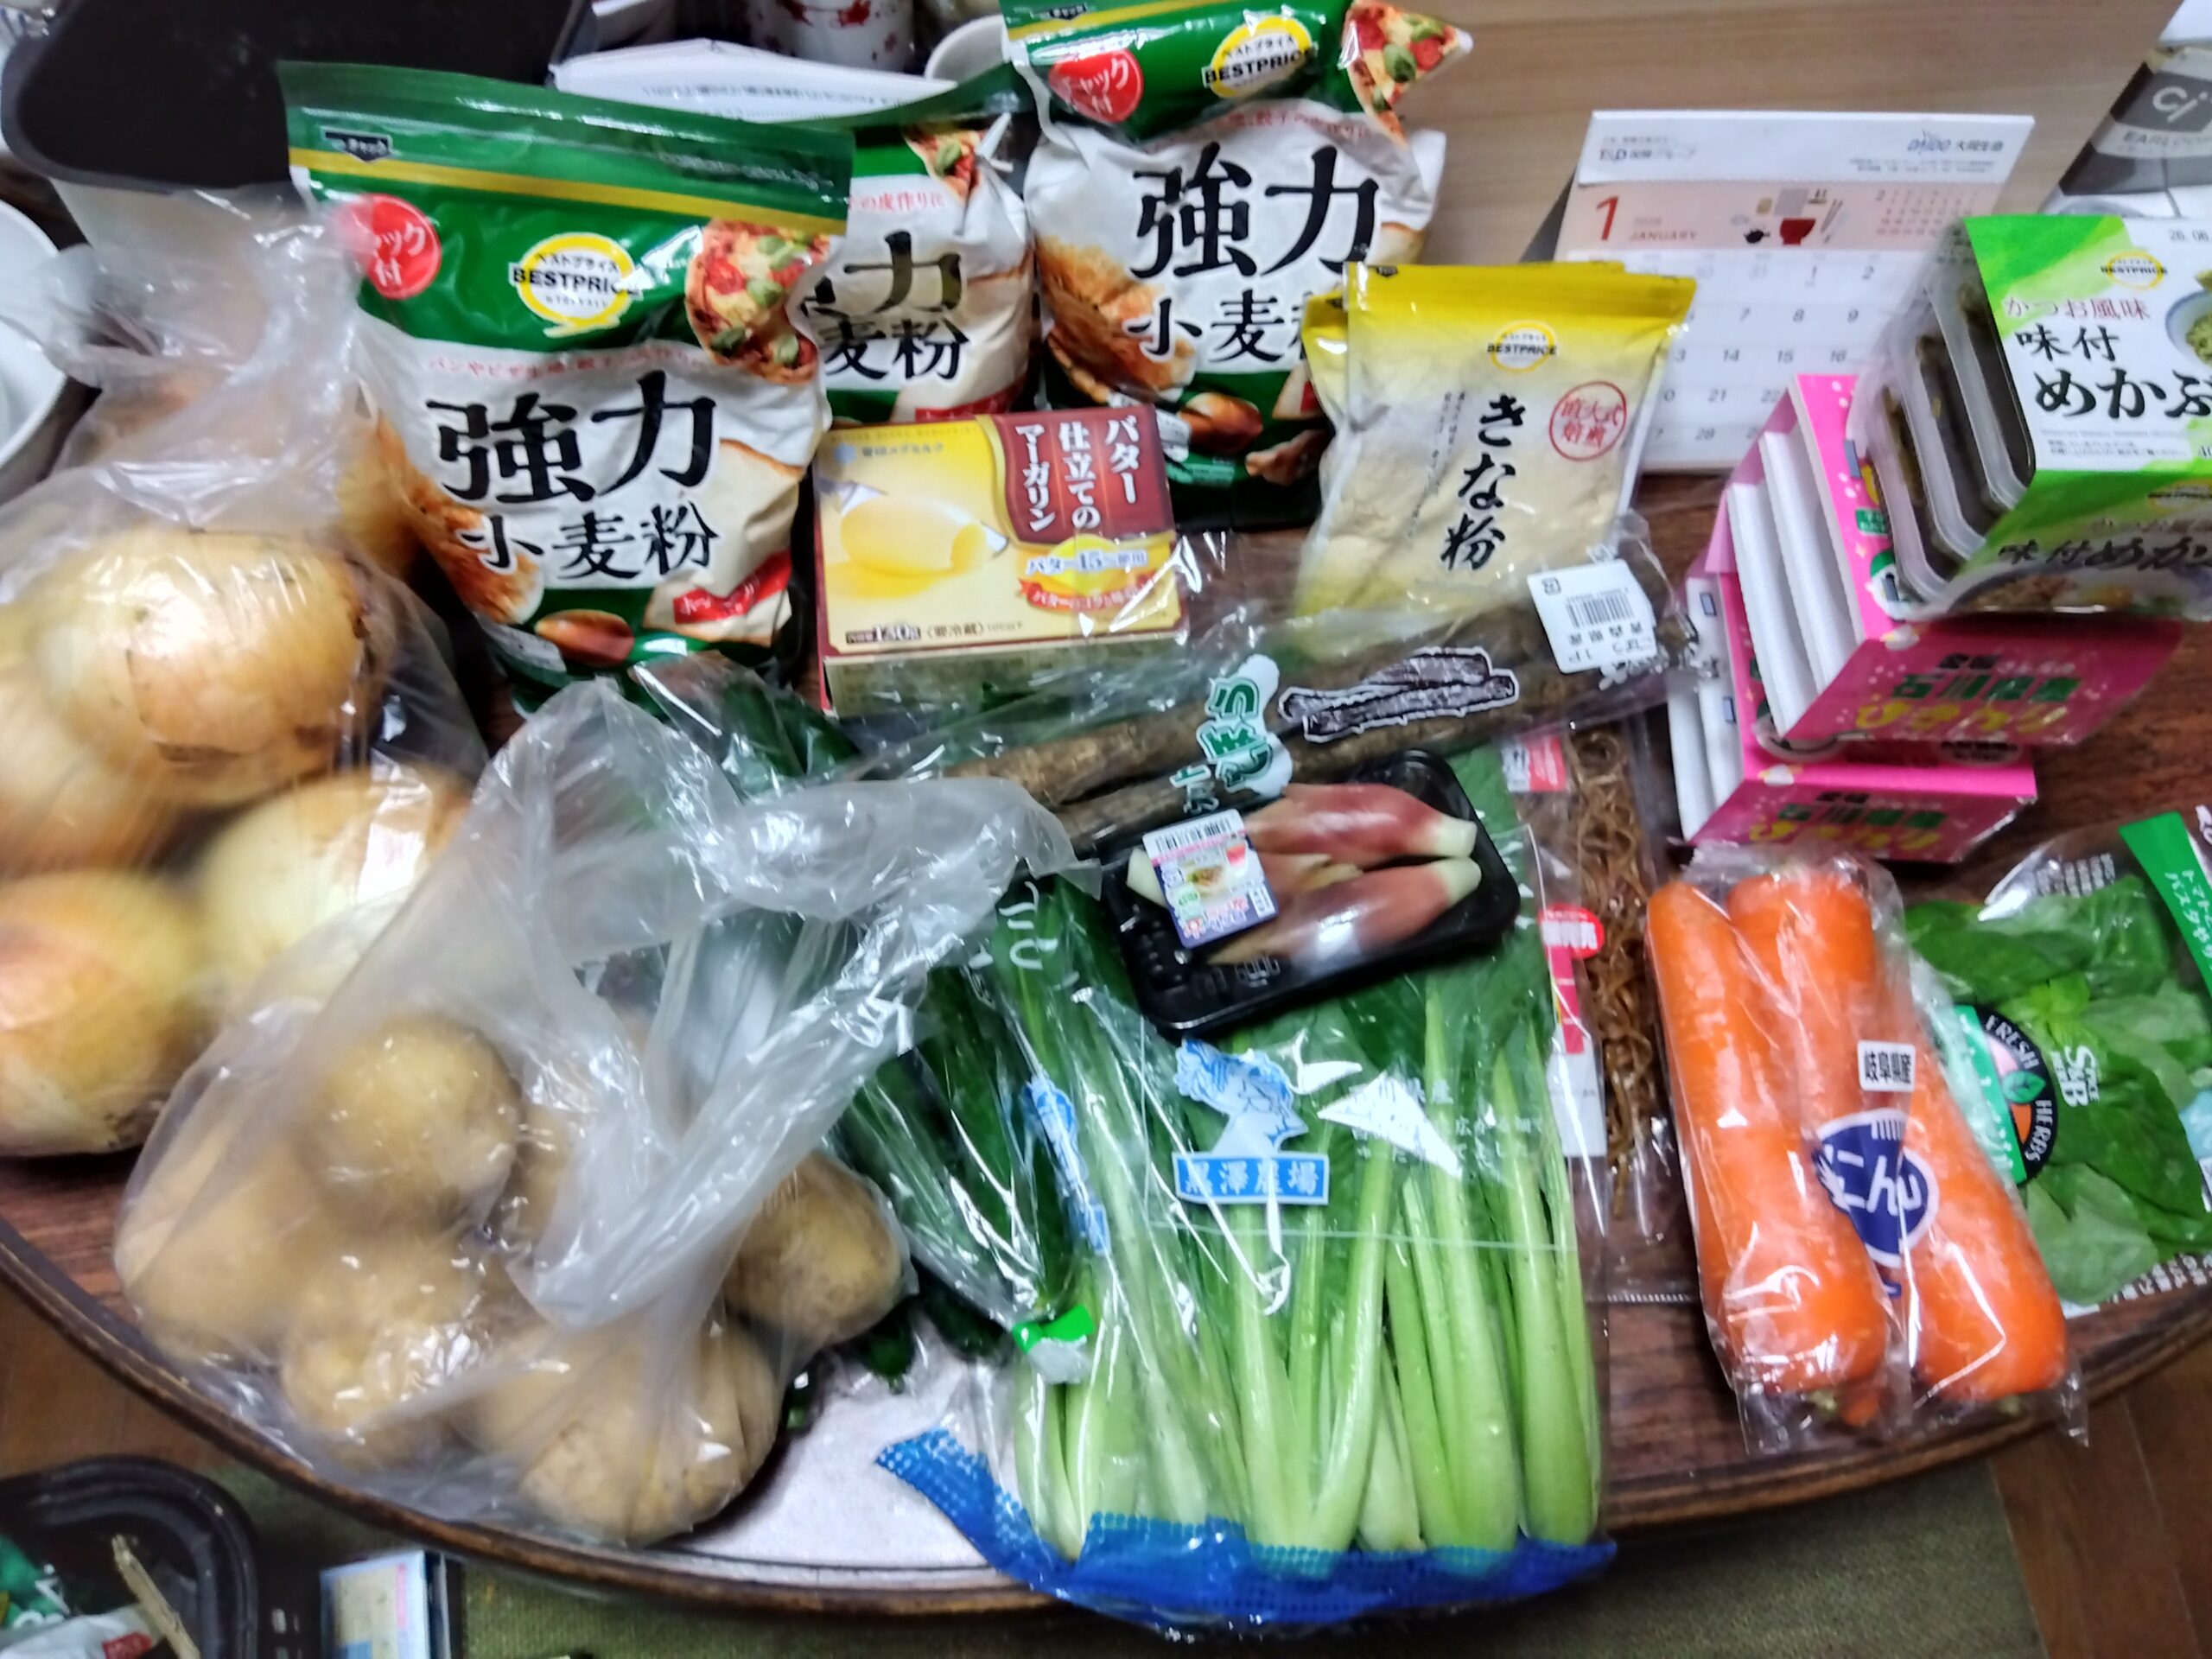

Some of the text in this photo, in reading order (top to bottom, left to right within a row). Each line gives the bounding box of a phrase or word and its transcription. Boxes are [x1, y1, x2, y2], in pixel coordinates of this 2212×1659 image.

[1130, 141, 1379, 278] 強力
[1594, 195, 1619, 242] 1
[1628, 229, 1698, 242] JANUARY
[1860, 265, 1875, 281] 2
[1127, 289, 1307, 364] 小麦
[1738, 306, 1860, 325] 7 8 9
[2004, 297, 2150, 321] かつお風味
[821, 316, 970, 380] 麦粉
[1722, 347, 1741, 364] 14
[1776, 348, 1795, 365] 15
[1829, 348, 1848, 365] 16
[2013, 322, 2120, 363] 味付
[1707, 388, 1727, 404] 21
[2033, 366, 2212, 420] めかぶ
[426, 369, 717, 502] 強力
[1103, 415, 1141, 505] バター
[1014, 423, 1057, 532] マーガリン
[1058, 422, 1102, 530] 仕立ての
[1440, 393, 1527, 571] きな粉
[456, 500, 721, 579] 小麦粉
[1863, 1050, 1913, 1084] 岐阜県産
[1986, 1014, 2040, 1070] FRESH
[2024, 1099, 2054, 1162] HERBS
